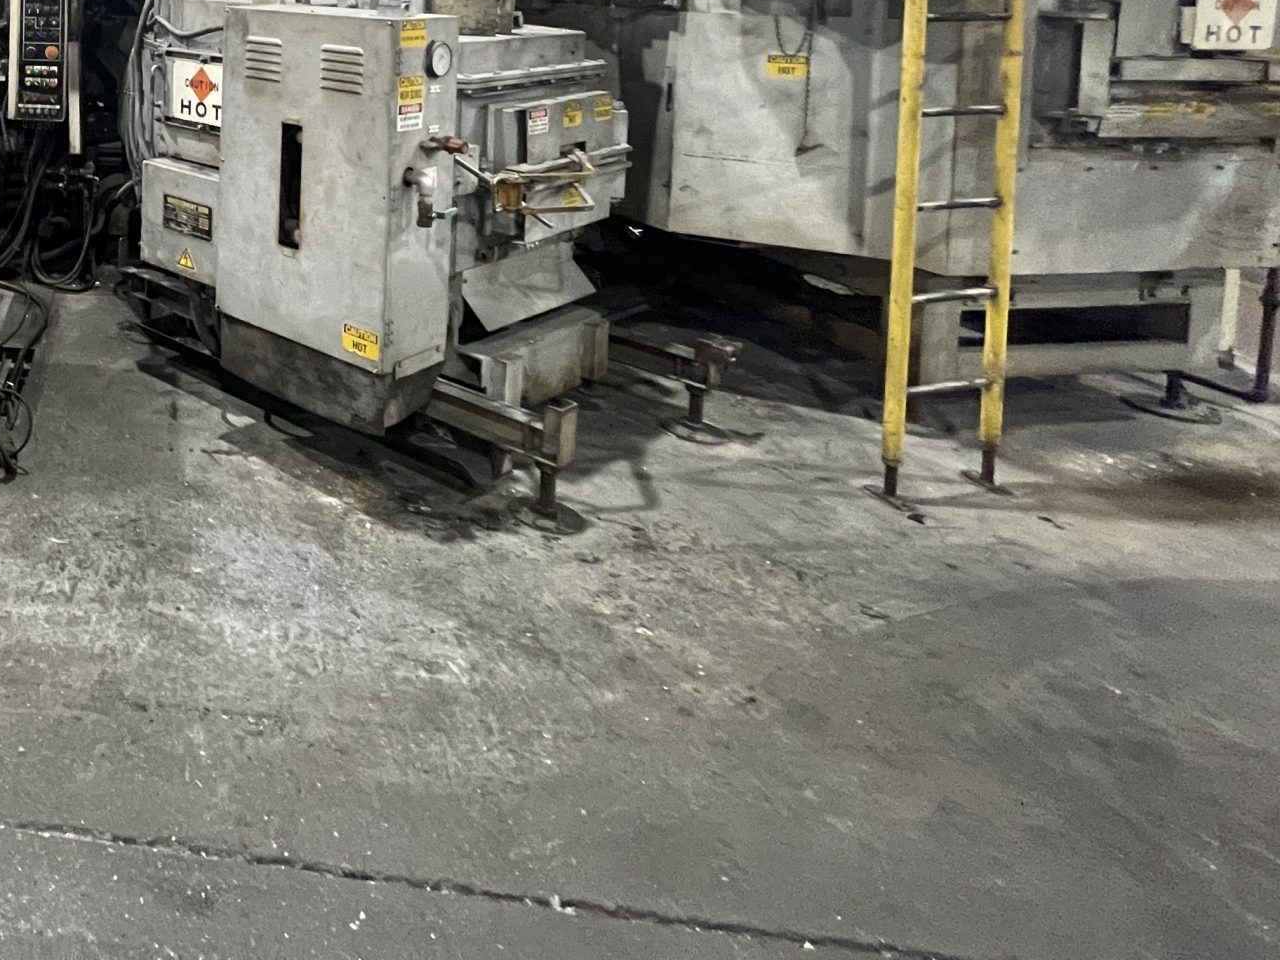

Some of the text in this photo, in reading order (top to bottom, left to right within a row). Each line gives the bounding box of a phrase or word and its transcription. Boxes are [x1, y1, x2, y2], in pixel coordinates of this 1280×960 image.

[1205, 25, 1263, 44] HOT
[777, 66, 796, 75] HOT
[184, 78, 219, 92] CAUTION
[180, 98, 222, 121] HOT
[351, 339, 368, 354] HOT
